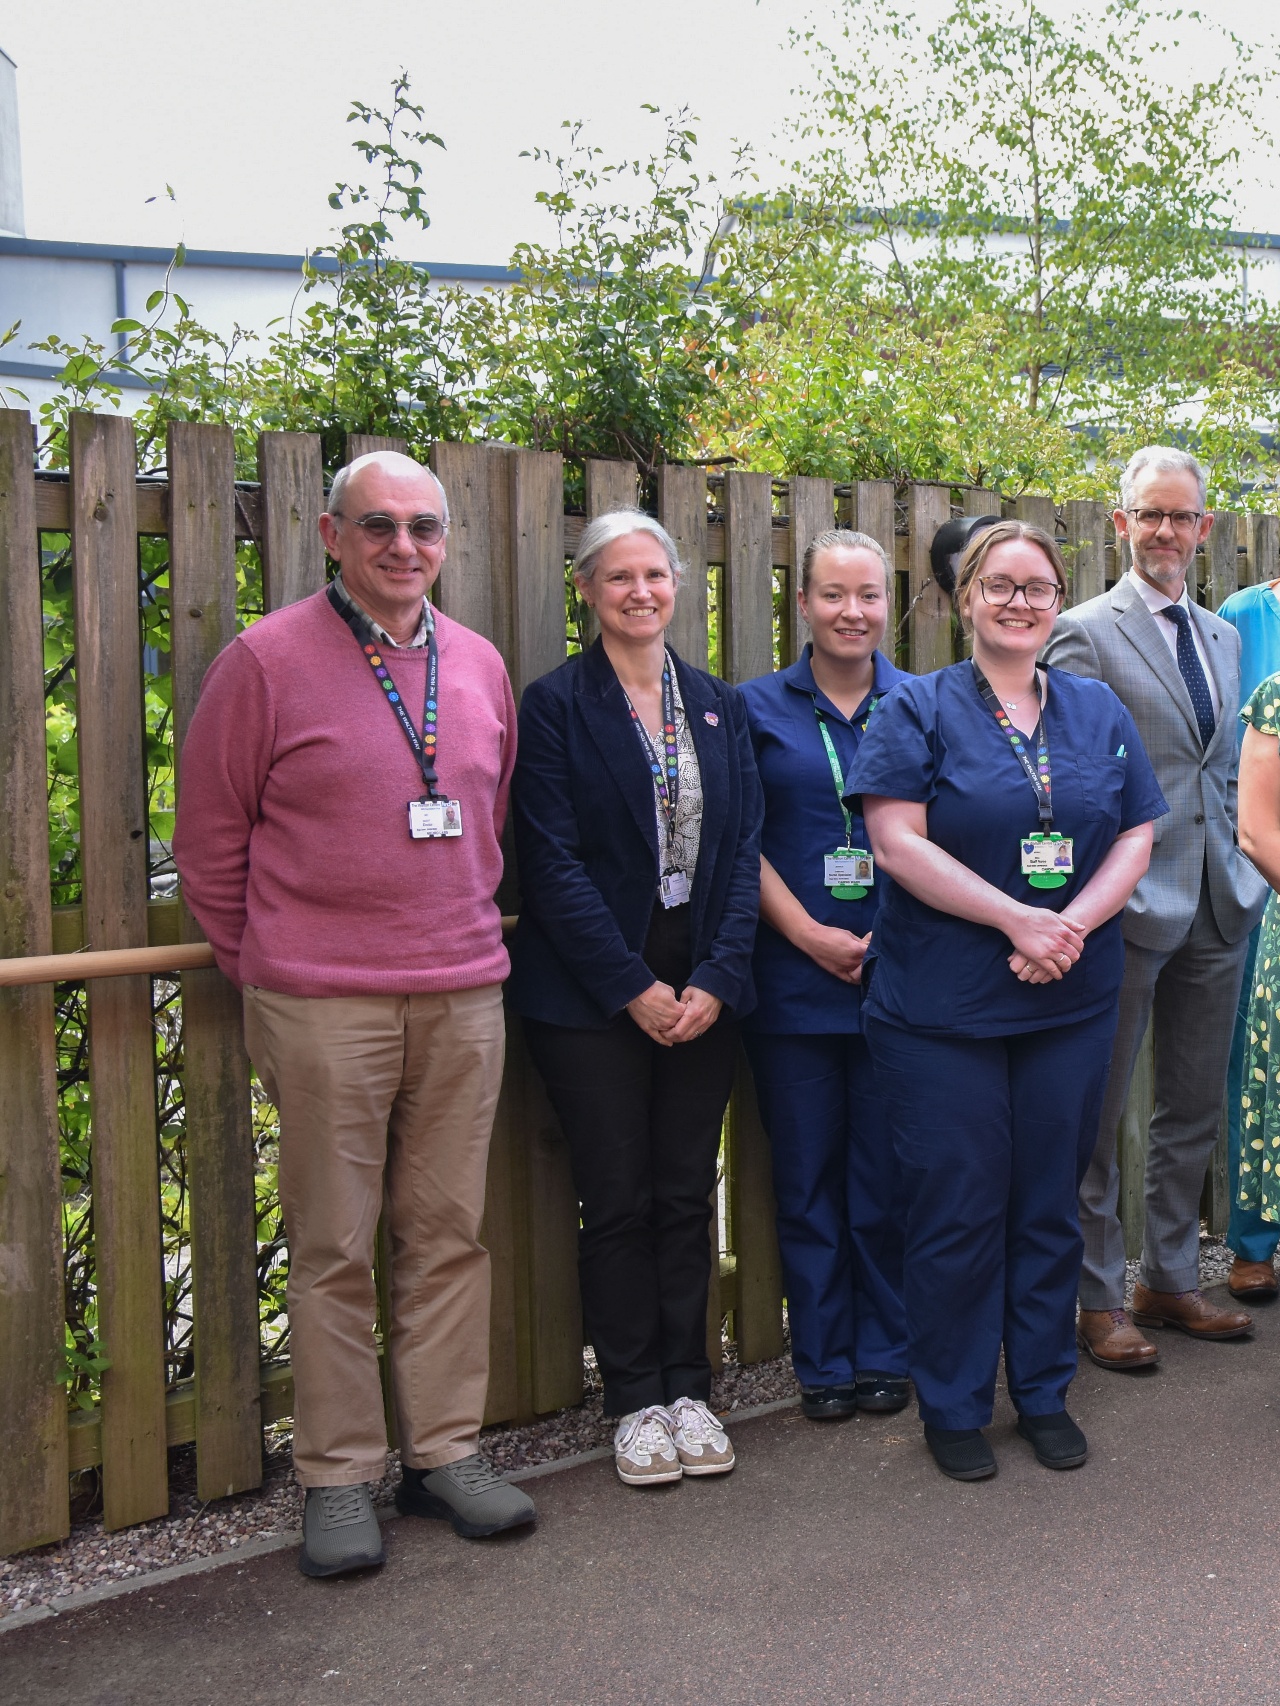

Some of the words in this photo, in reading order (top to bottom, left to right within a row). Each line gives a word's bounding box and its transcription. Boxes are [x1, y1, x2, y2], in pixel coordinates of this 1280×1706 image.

[397, 705, 406, 717] THE
[402, 716, 416, 738] WALTON
[412, 738, 421, 750] WAY
[1026, 764, 1038, 781] WALTON
